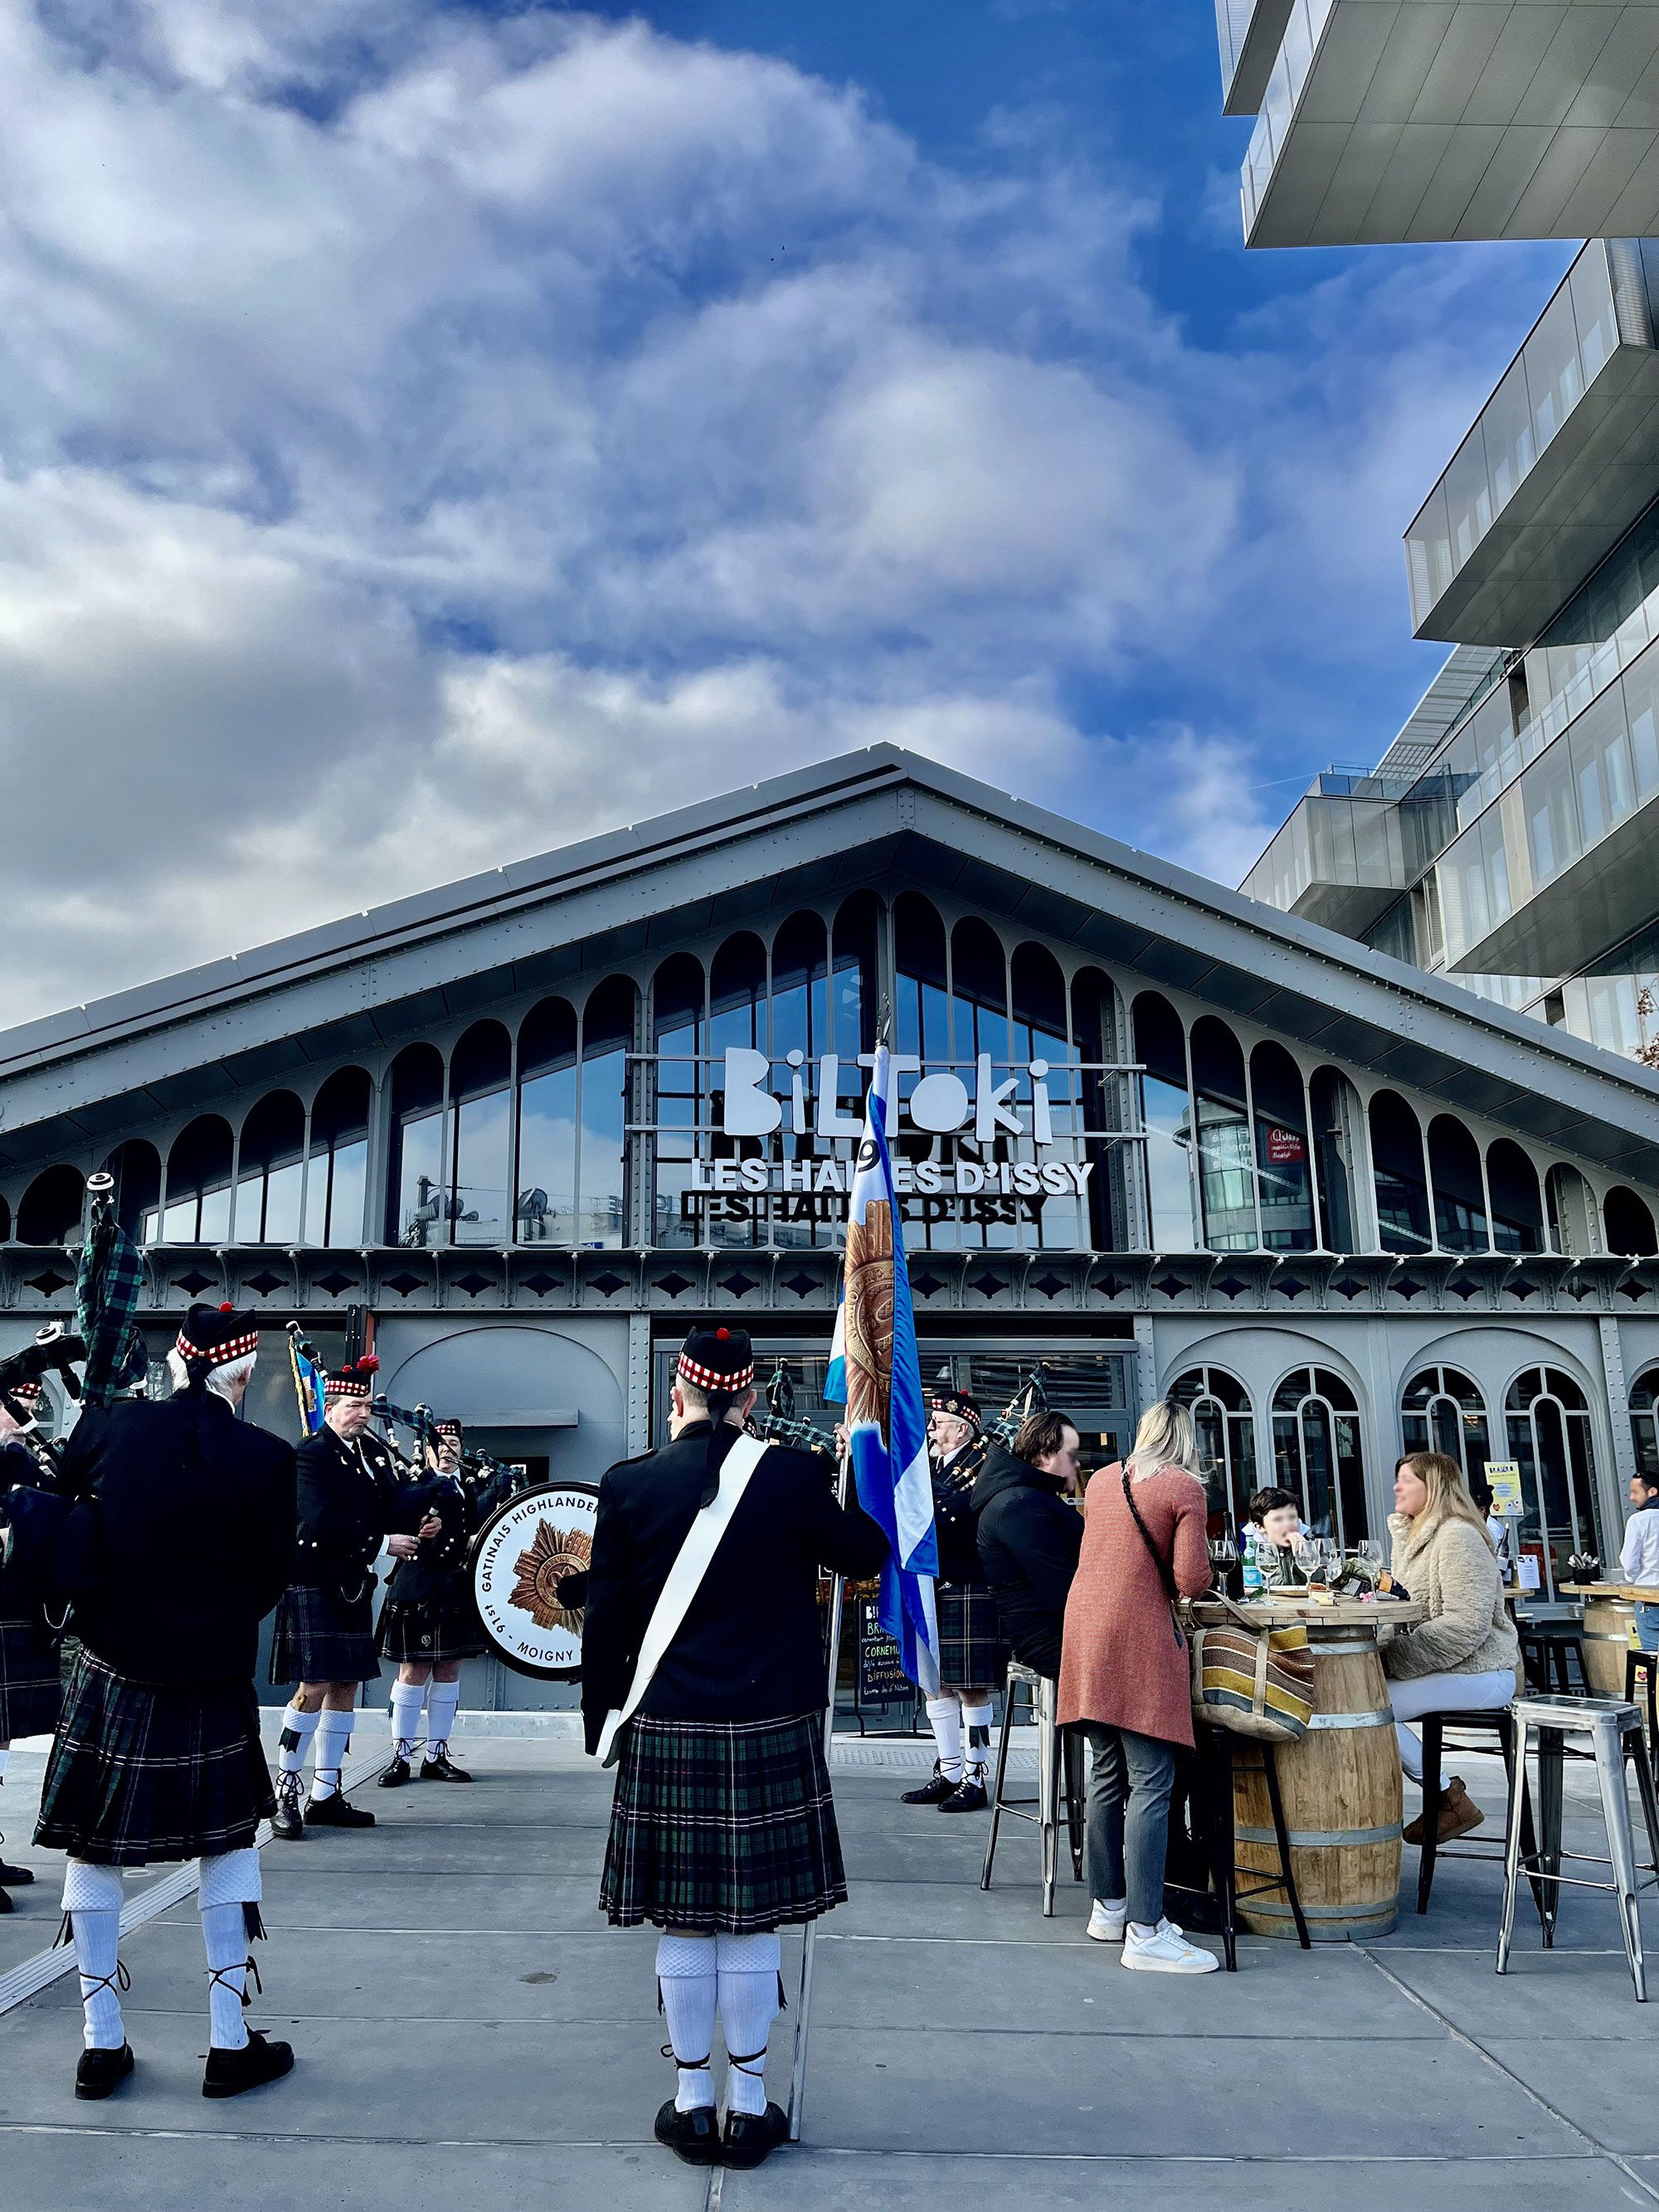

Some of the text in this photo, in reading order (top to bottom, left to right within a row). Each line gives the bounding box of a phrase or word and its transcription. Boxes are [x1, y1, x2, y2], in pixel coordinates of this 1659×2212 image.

[691, 1158, 1095, 1196] LES HAES D'ISSY
[482, 1524, 511, 1592] GATINAIS
[517, 1641, 573, 1662] MOIGNY
